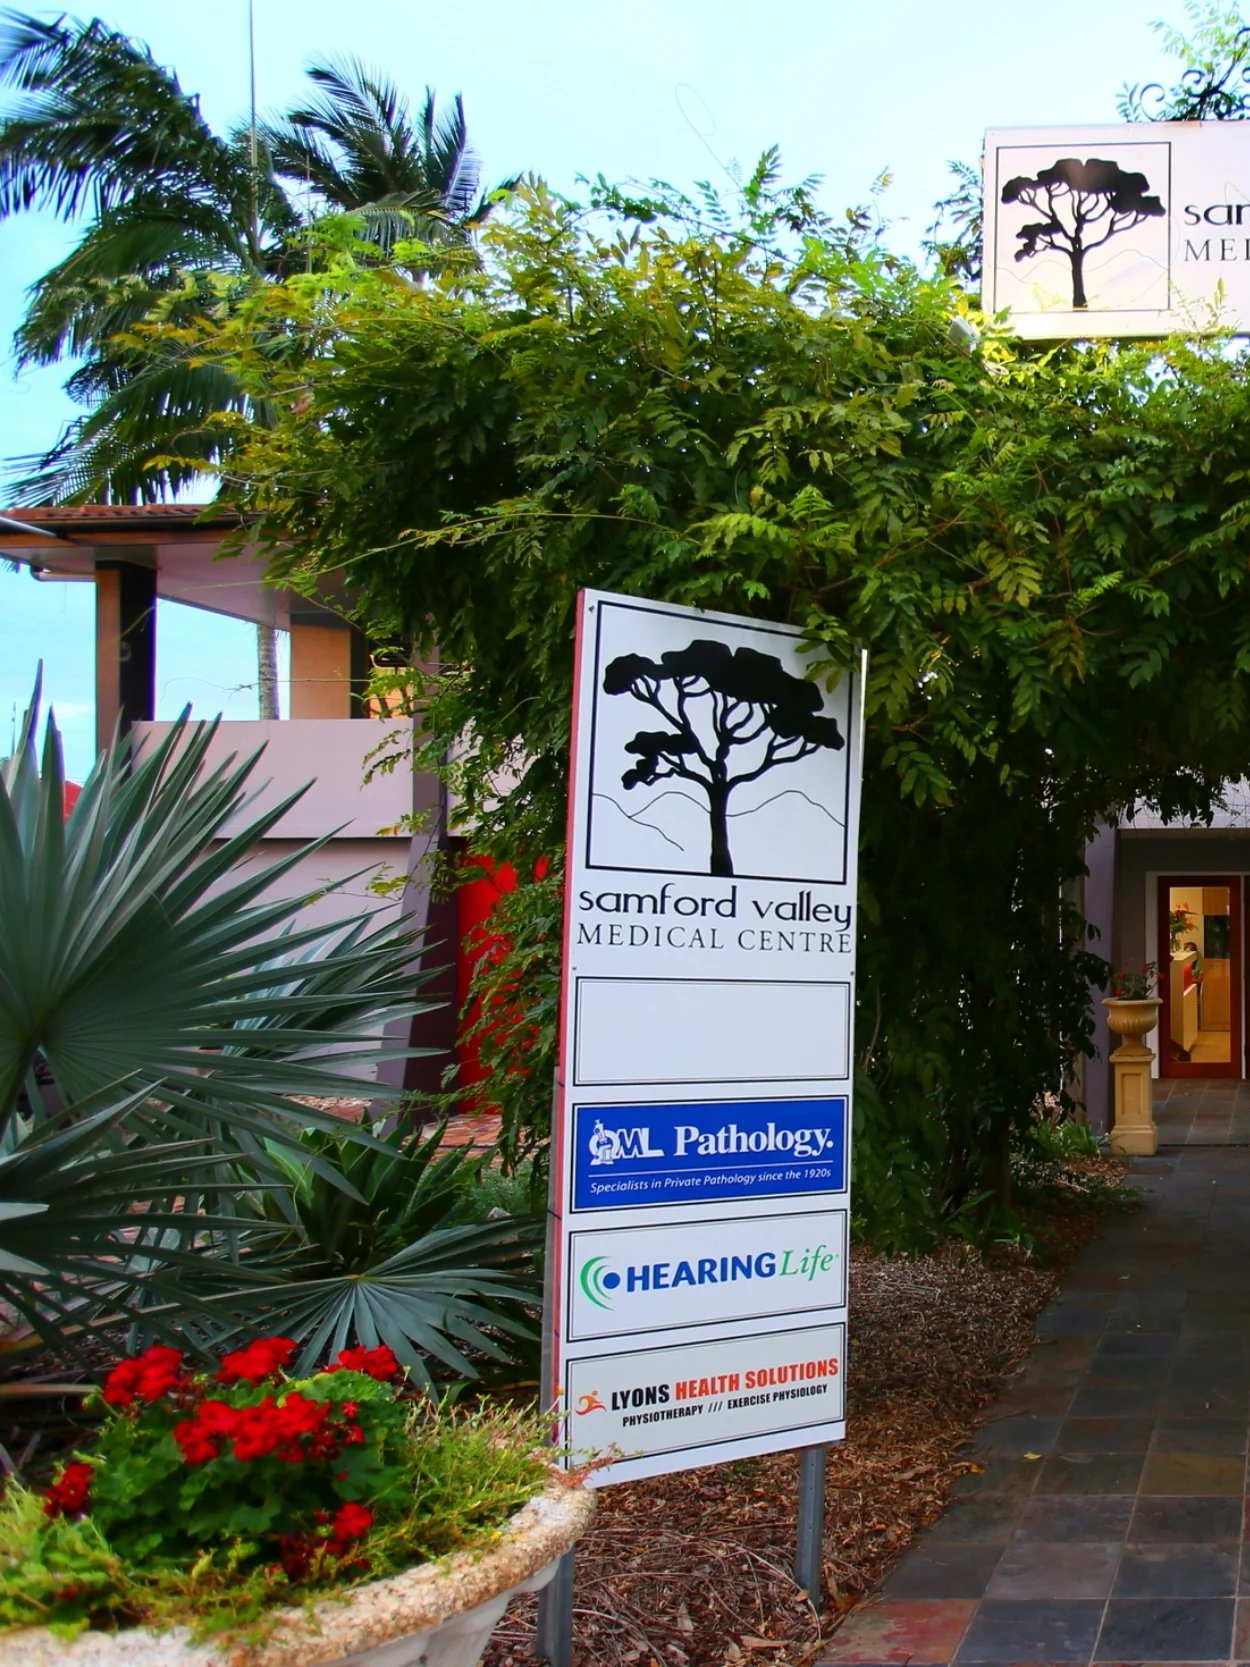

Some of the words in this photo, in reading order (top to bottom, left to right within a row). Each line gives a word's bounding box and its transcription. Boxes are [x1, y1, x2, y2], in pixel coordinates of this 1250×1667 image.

[578, 883, 738, 918] samford
[751, 890, 852, 932] valley
[577, 923, 724, 949] MEDICAL
[738, 929, 852, 953] CENTRE
[590, 1178, 649, 1195] Specialists
[651, 1177, 662, 1189] in
[664, 1175, 702, 1188] Private
[703, 1172, 757, 1186] Pathology
[758, 1171, 784, 1183] since
[785, 1169, 802, 1180] the
[804, 1167, 832, 1179] 1920s
[611, 1383, 670, 1412] LYONS
[675, 1373, 741, 1401] HEALTH
[745, 1358, 839, 1388] SOLUTIONS
[622, 1404, 704, 1427] PHYSIOTHERAPY
[727, 1393, 771, 1410] EXERCISE
[773, 1383, 828, 1403] PHYSIOLOGY
